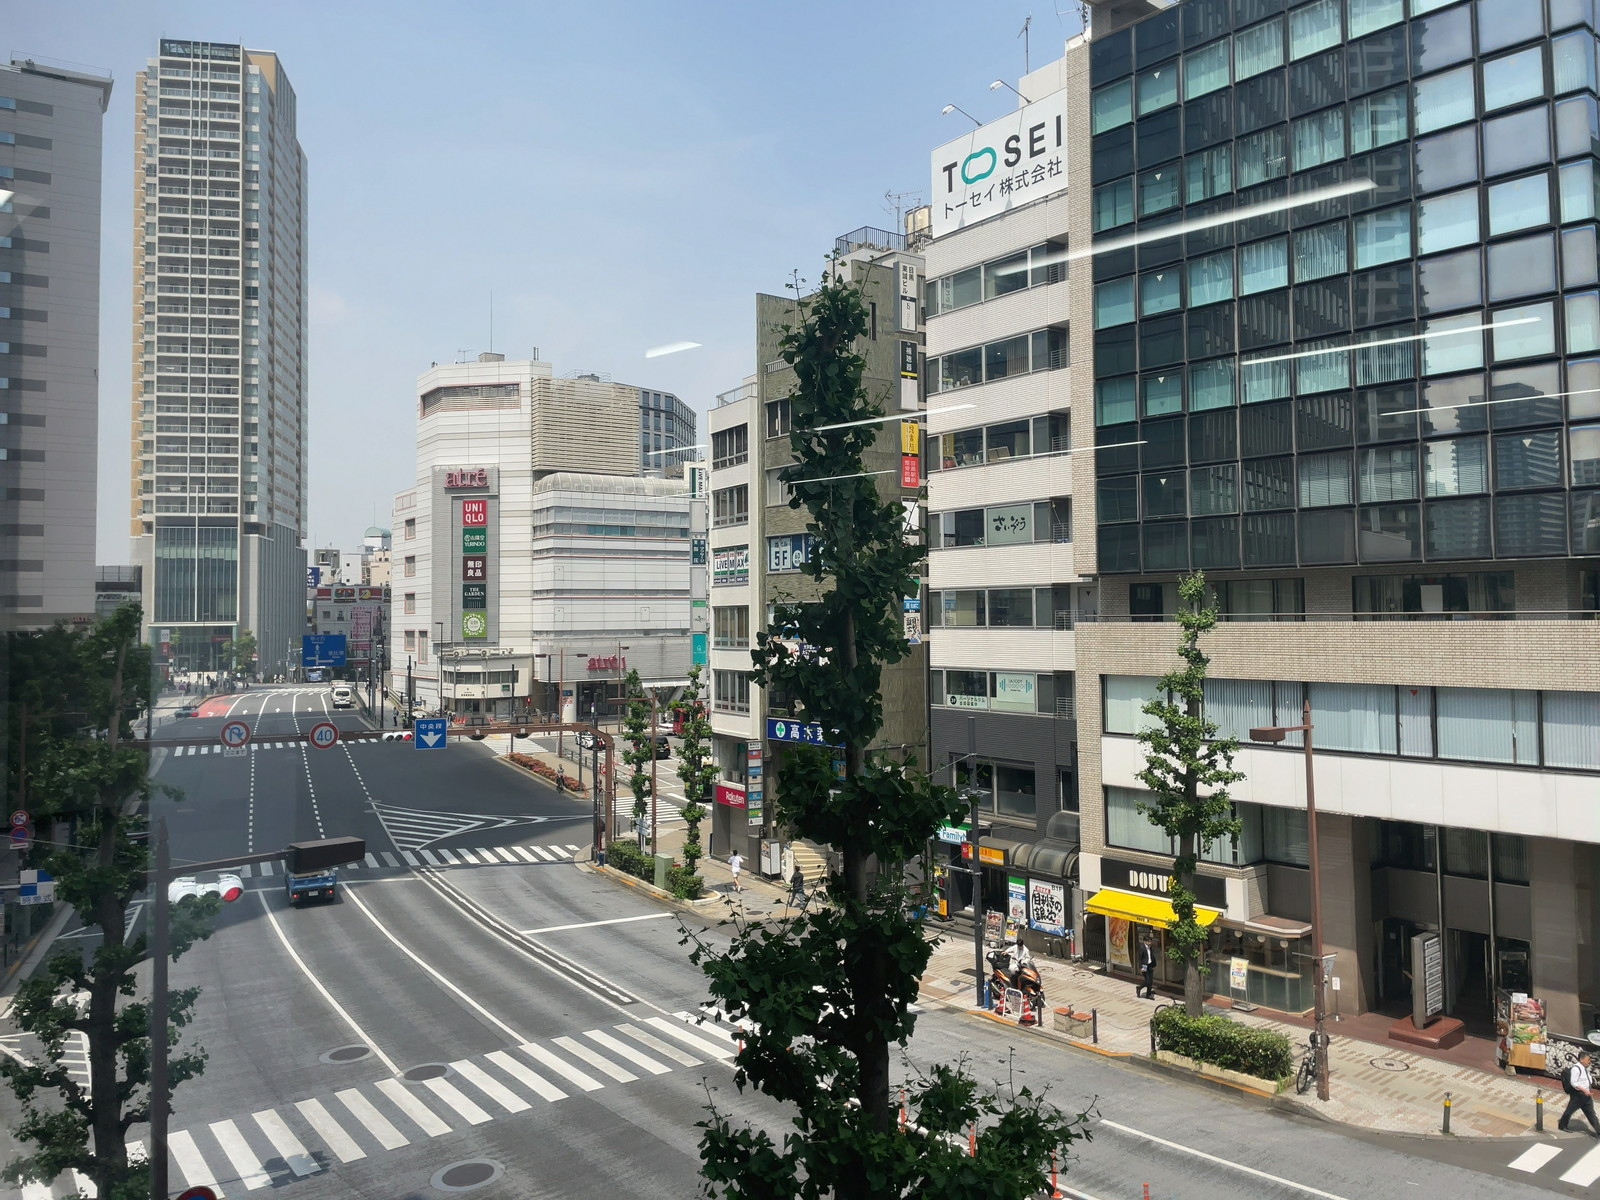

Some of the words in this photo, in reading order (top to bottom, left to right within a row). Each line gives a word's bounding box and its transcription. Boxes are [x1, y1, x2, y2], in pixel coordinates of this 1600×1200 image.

[942, 114, 1062, 194] TOSEI
[944, 156, 1063, 220] トーセイ株式会社
[445, 468, 488, 487] atré
[465, 503, 482, 512] UNI
[465, 513, 484, 523] QLO
[467, 560, 482, 568] 無印
[774, 550, 788, 567] 5F
[467, 569, 482, 577] 良品
[420, 722, 443, 730] 中央線
[316, 729, 332, 742] 40
[725, 790, 745, 804] Rakuten
[1051, 884, 1063, 893] B1F
